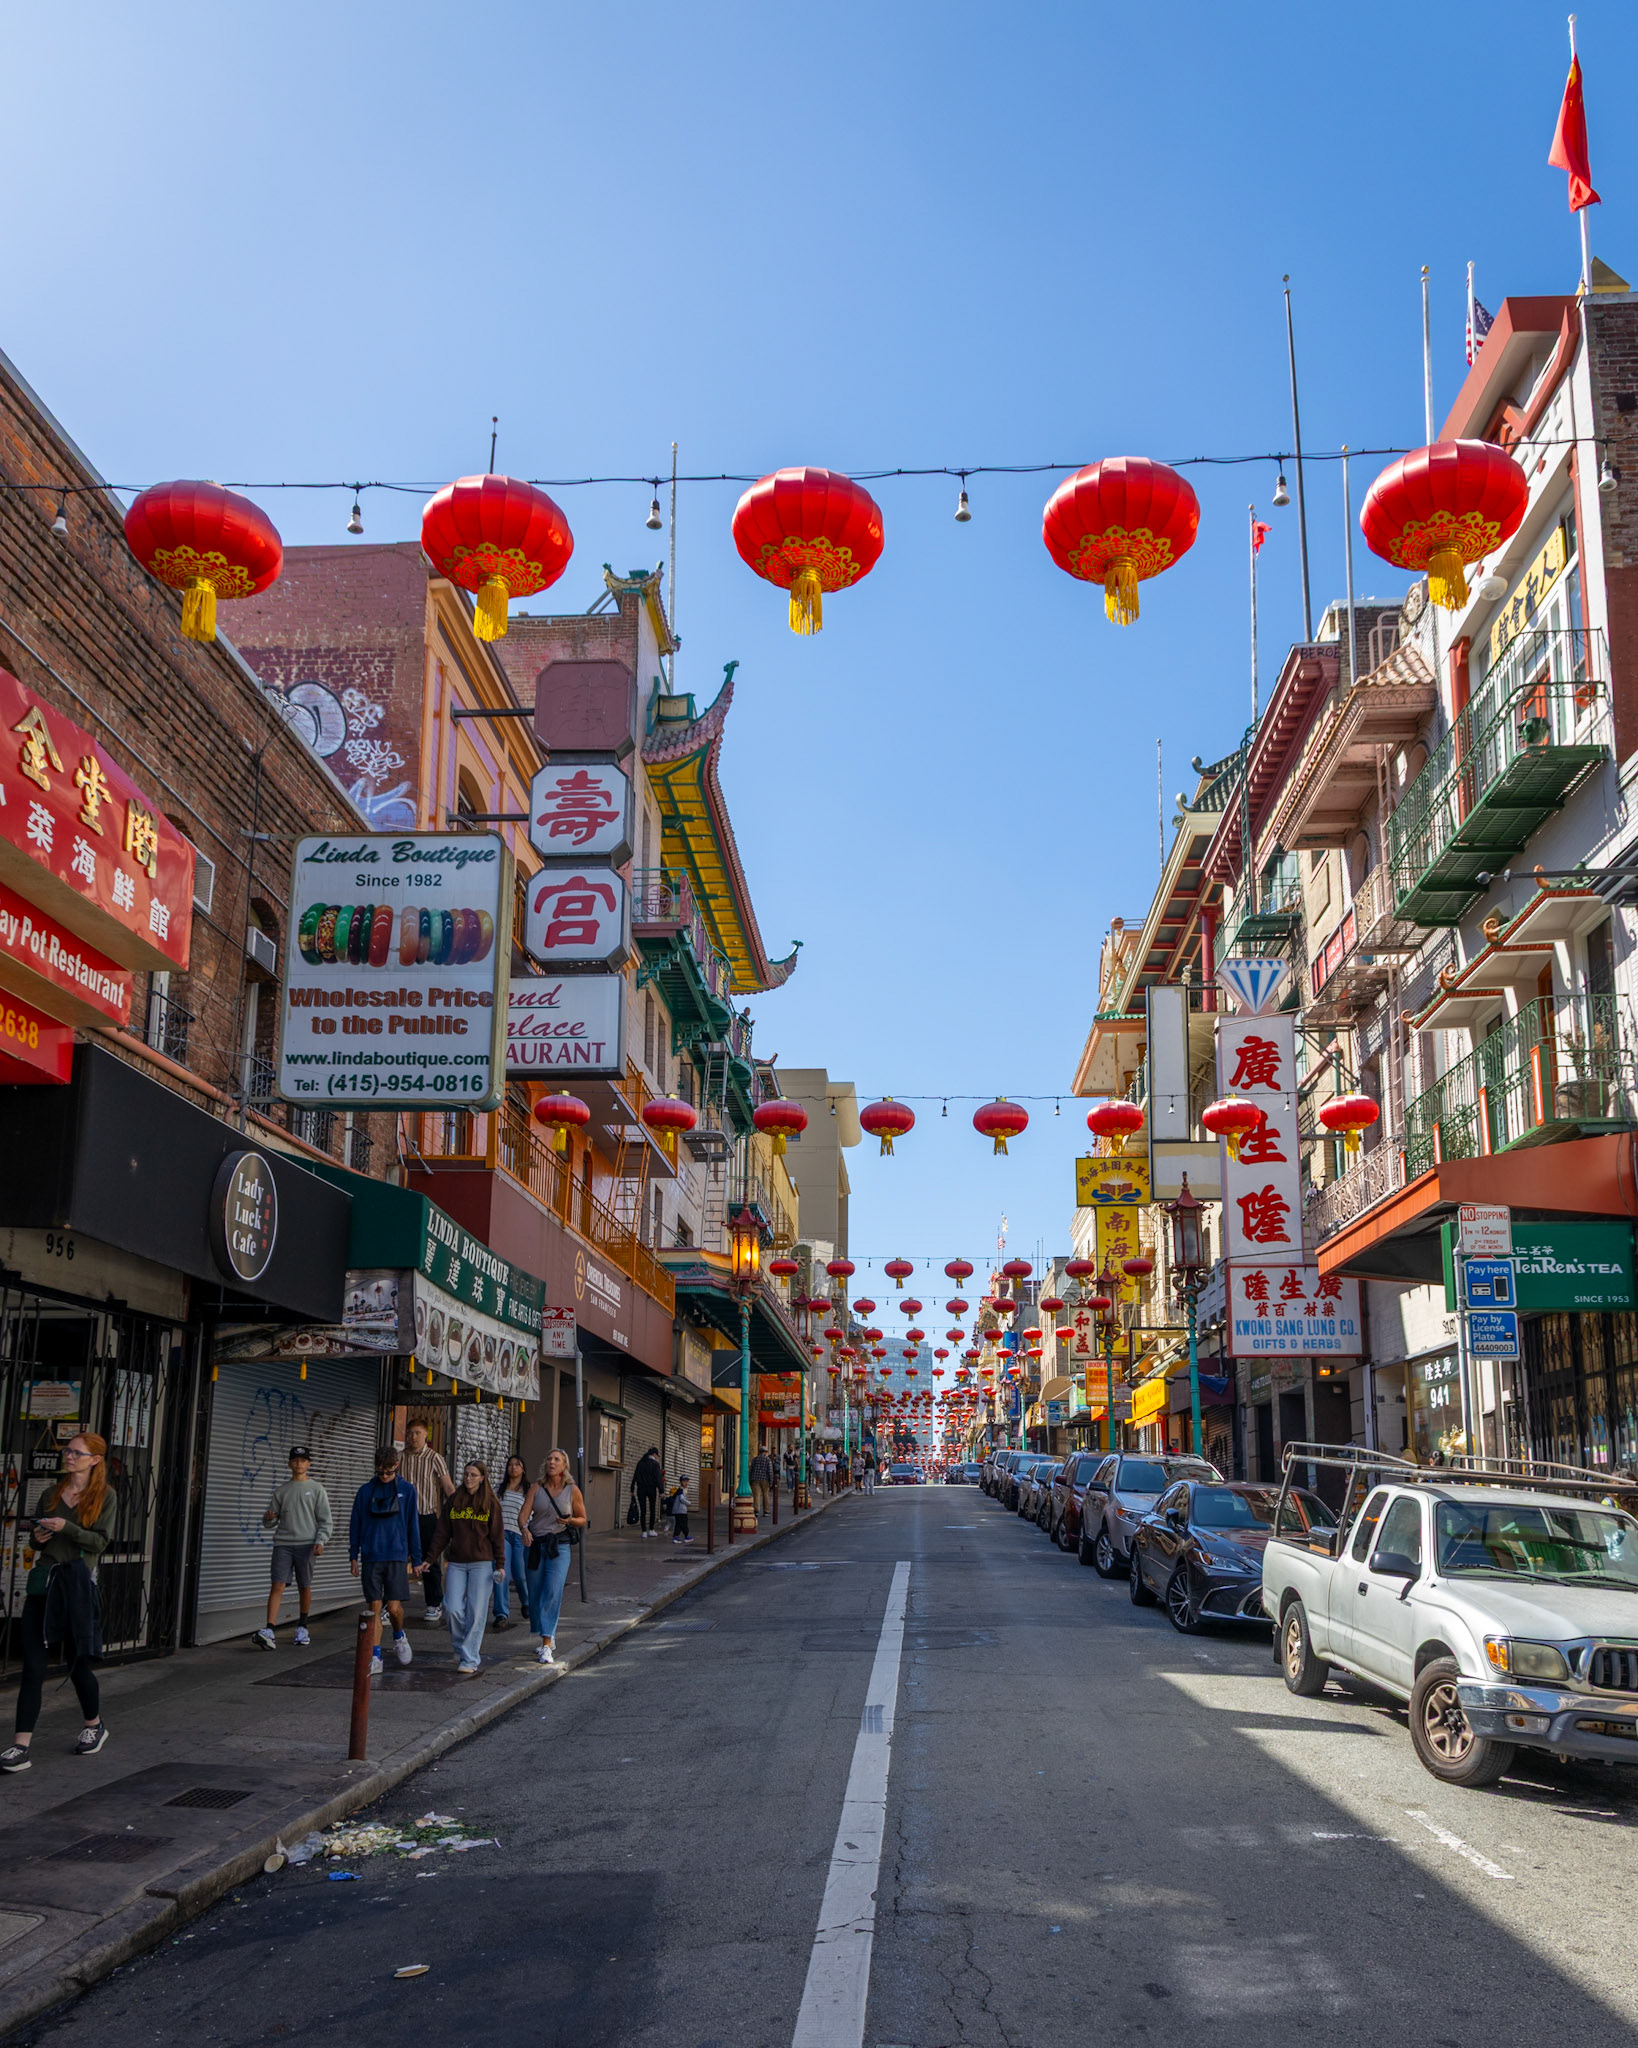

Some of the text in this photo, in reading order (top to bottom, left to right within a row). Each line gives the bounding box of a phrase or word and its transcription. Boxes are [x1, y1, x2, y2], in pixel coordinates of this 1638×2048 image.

[0, 783, 170, 941] 菜海鮮館
[303, 841, 496, 869] Linda Boutique
[355, 874, 442, 886] Since 1982
[21, 916, 47, 958] Pot
[49, 935, 124, 1008] Restaurant
[289, 988, 494, 1007] Wholesale Price
[311, 1015, 468, 1034] to the Public
[286, 1052, 489, 1068] www.lindaboutique.com
[294, 1074, 483, 1095] Tel: (415)-954-0816
[237, 1172, 264, 1205] Lady
[234, 1201, 261, 1230] Luck
[1462, 1207, 1508, 1220] NO STOPPING
[46, 1233, 74, 1260] 956
[233, 1229, 256, 1256] Cafe
[427, 1208, 459, 1253] LINDA
[462, 1236, 509, 1286] BOUTIQUE
[1468, 1265, 1510, 1276] Pay here
[1587, 1264, 1623, 1273] TEA
[590, 1293, 616, 1318] SAN FRANCISCO
[1574, 1295, 1630, 1303] SINCE 1953
[508, 1298, 518, 1320] FINE
[543, 1318, 551, 1328] NO
[1471, 1314, 1502, 1325] Pay by
[552, 1331, 565, 1339] ANY
[1236, 1320, 1358, 1336] KWONG SANG LUNG CO.
[1472, 1324, 1505, 1332] License
[1473, 1332, 1496, 1340] Plate
[552, 1341, 566, 1349] TIME
[1253, 1339, 1341, 1349] GIFTS & HERBS
[1475, 1344, 1513, 1352] 44409003
[1430, 1384, 1449, 1408] 941
[33, 1457, 57, 1470] OPEN
